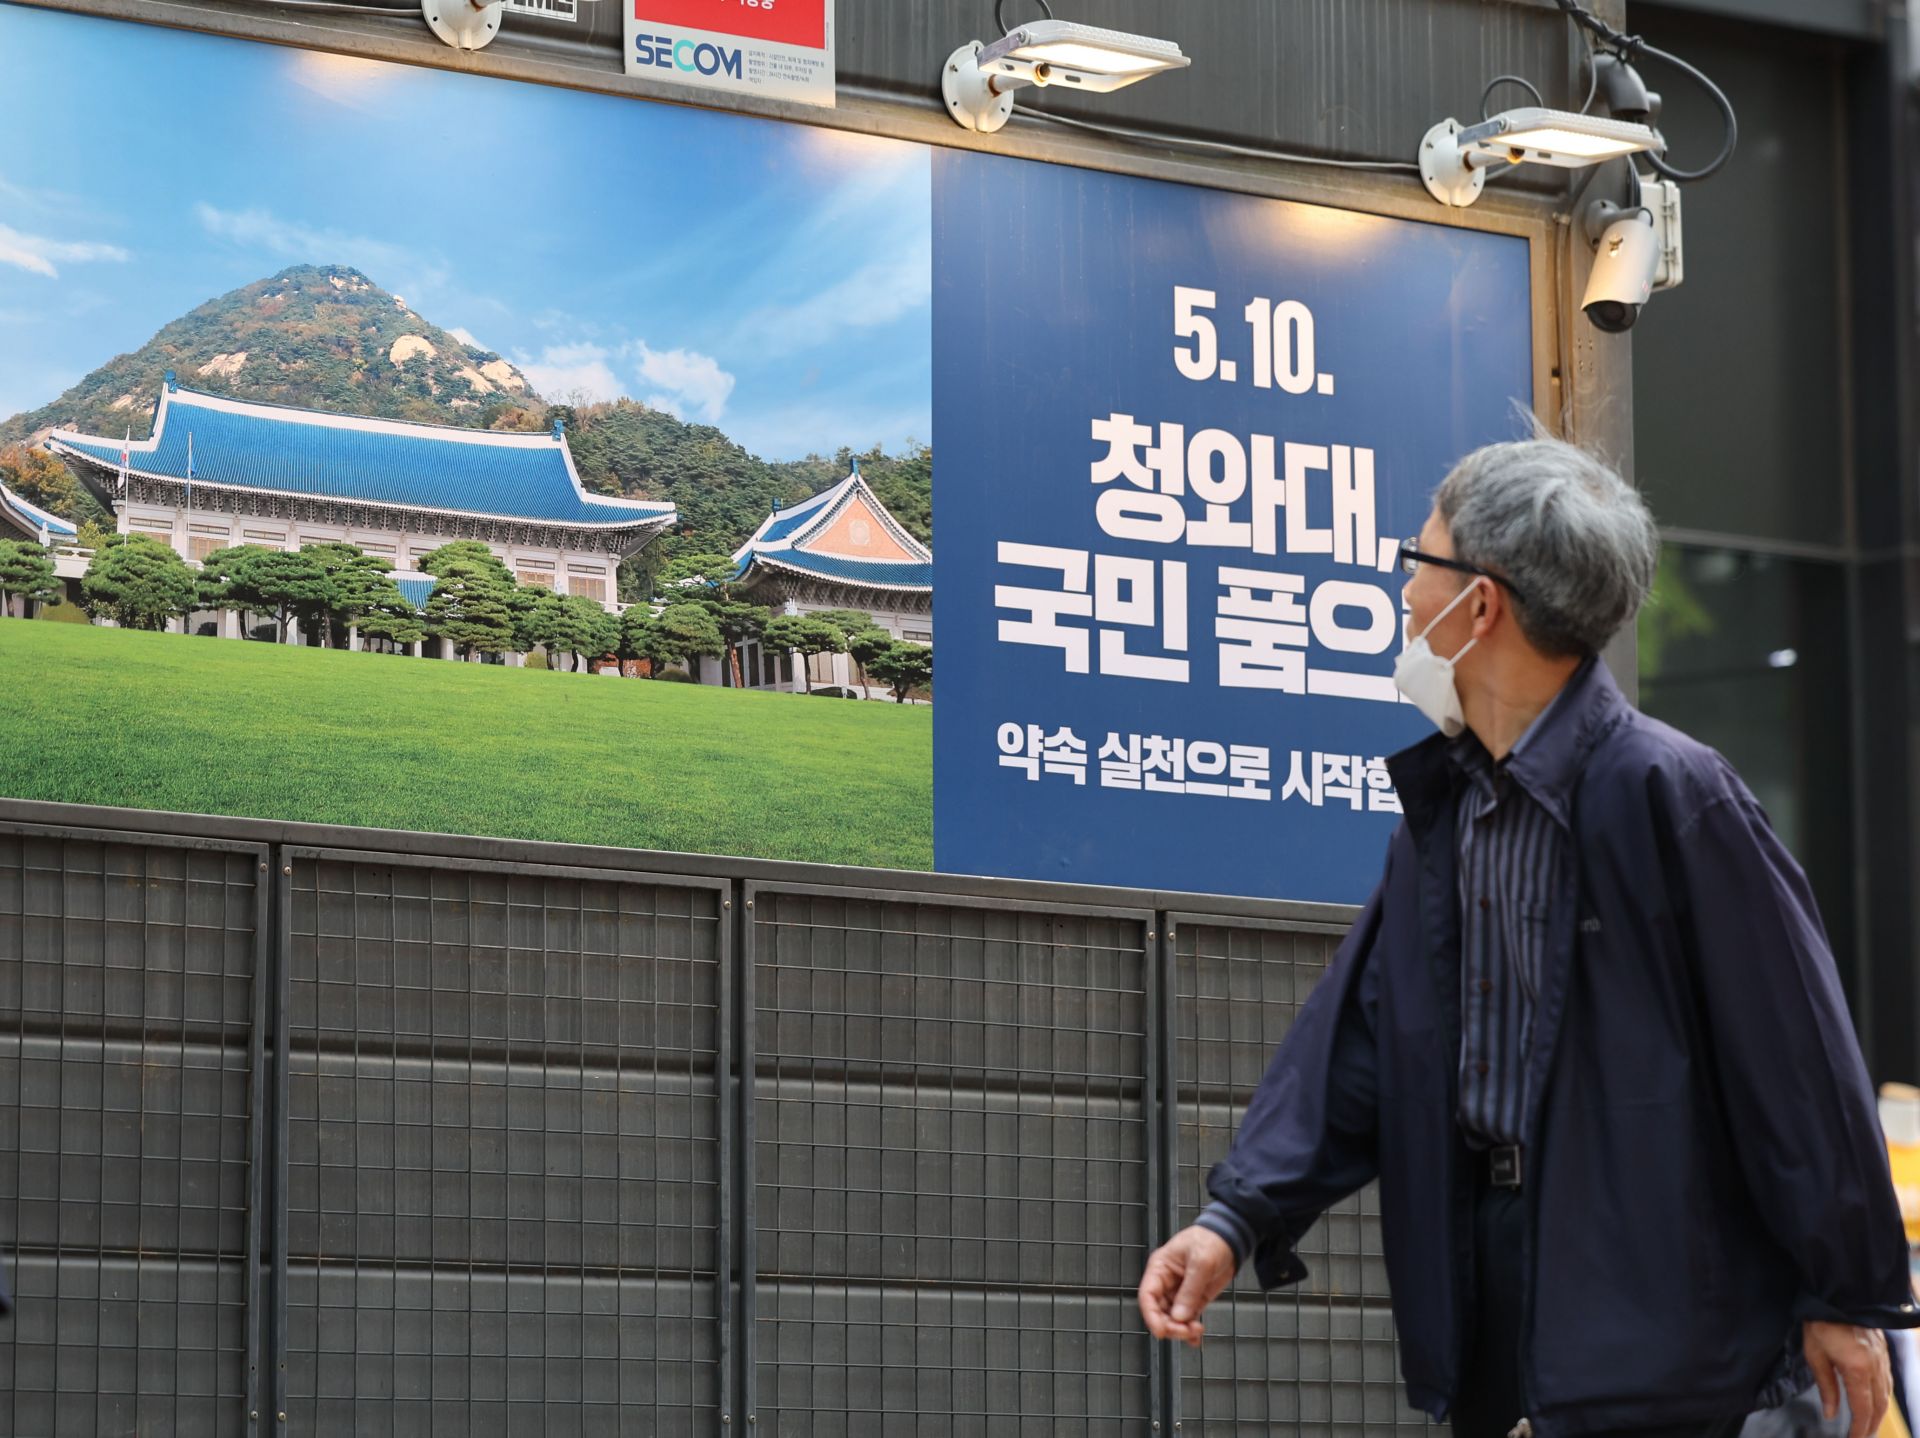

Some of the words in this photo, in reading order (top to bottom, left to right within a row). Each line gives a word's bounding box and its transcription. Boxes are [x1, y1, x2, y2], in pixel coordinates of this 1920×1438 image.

[635, 33, 743, 80] SECOM
[1090, 413, 1400, 573] 청와대,
[995, 541, 1190, 683] 국민
[1215, 566, 1417, 705] 품으
[997, 722, 1088, 786] 약속
[1098, 732, 1272, 801] 실천으로
